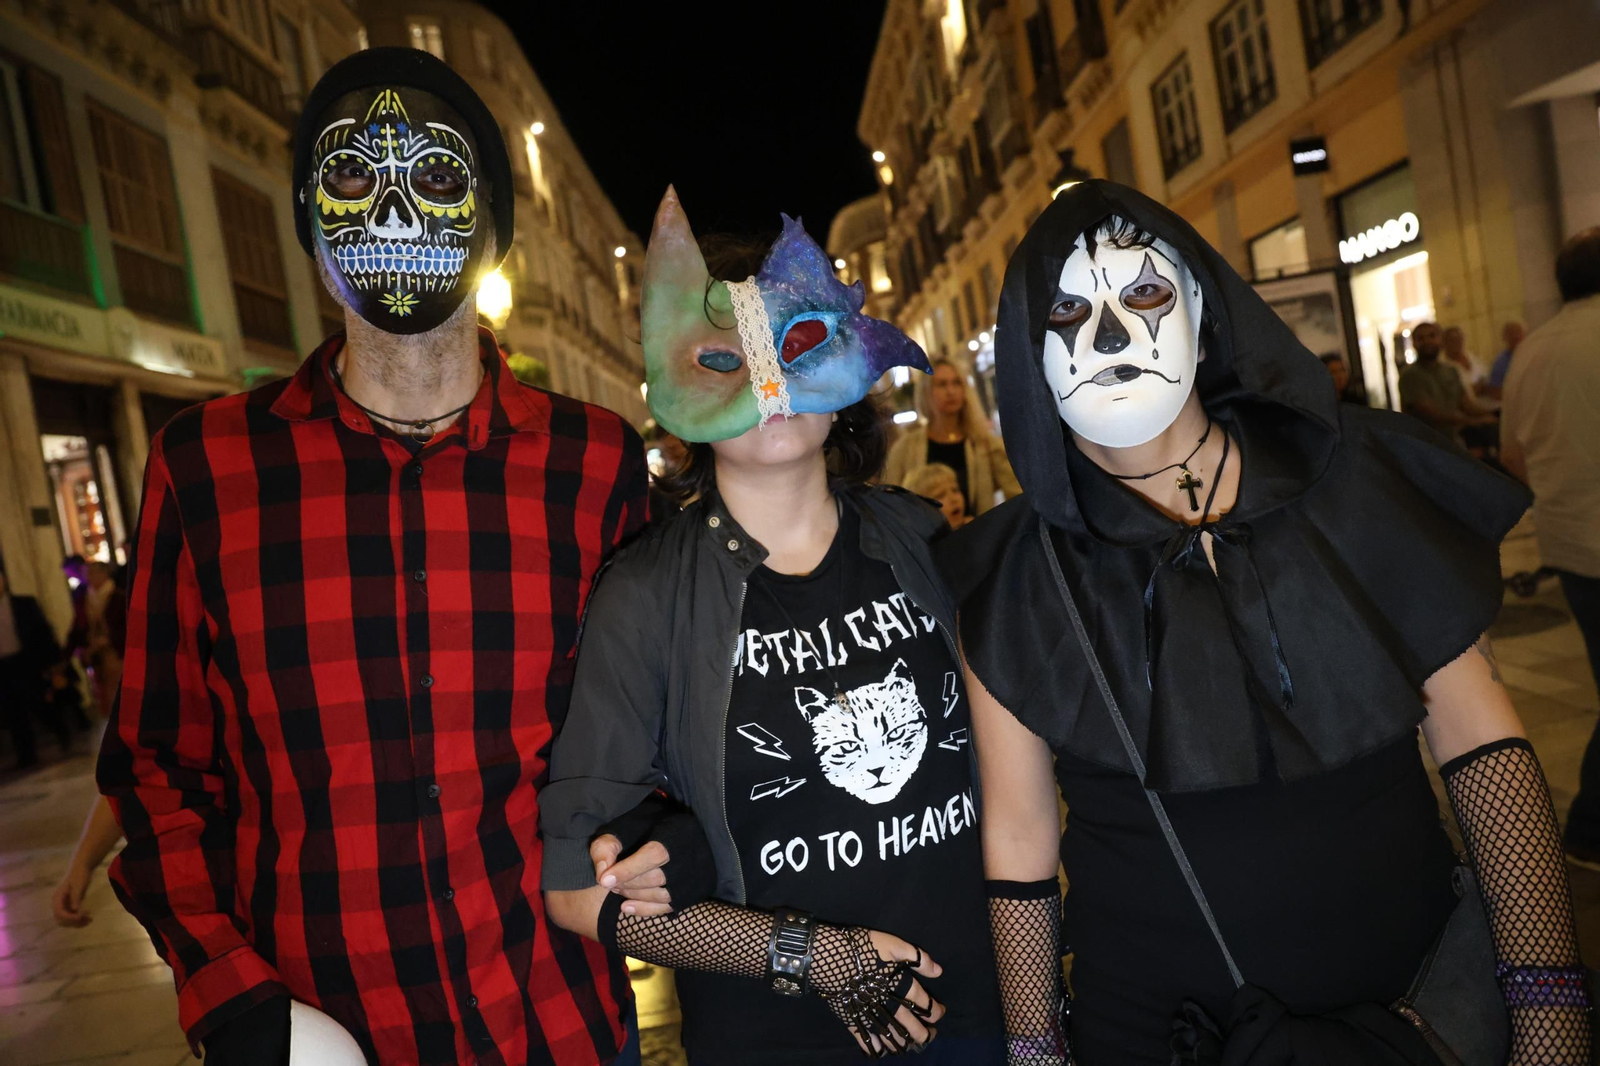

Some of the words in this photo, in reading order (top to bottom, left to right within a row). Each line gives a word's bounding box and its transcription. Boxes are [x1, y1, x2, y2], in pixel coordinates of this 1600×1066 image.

[760, 836, 810, 875] GO
[818, 830, 863, 871] TO
[878, 786, 977, 861] HEAVEN
